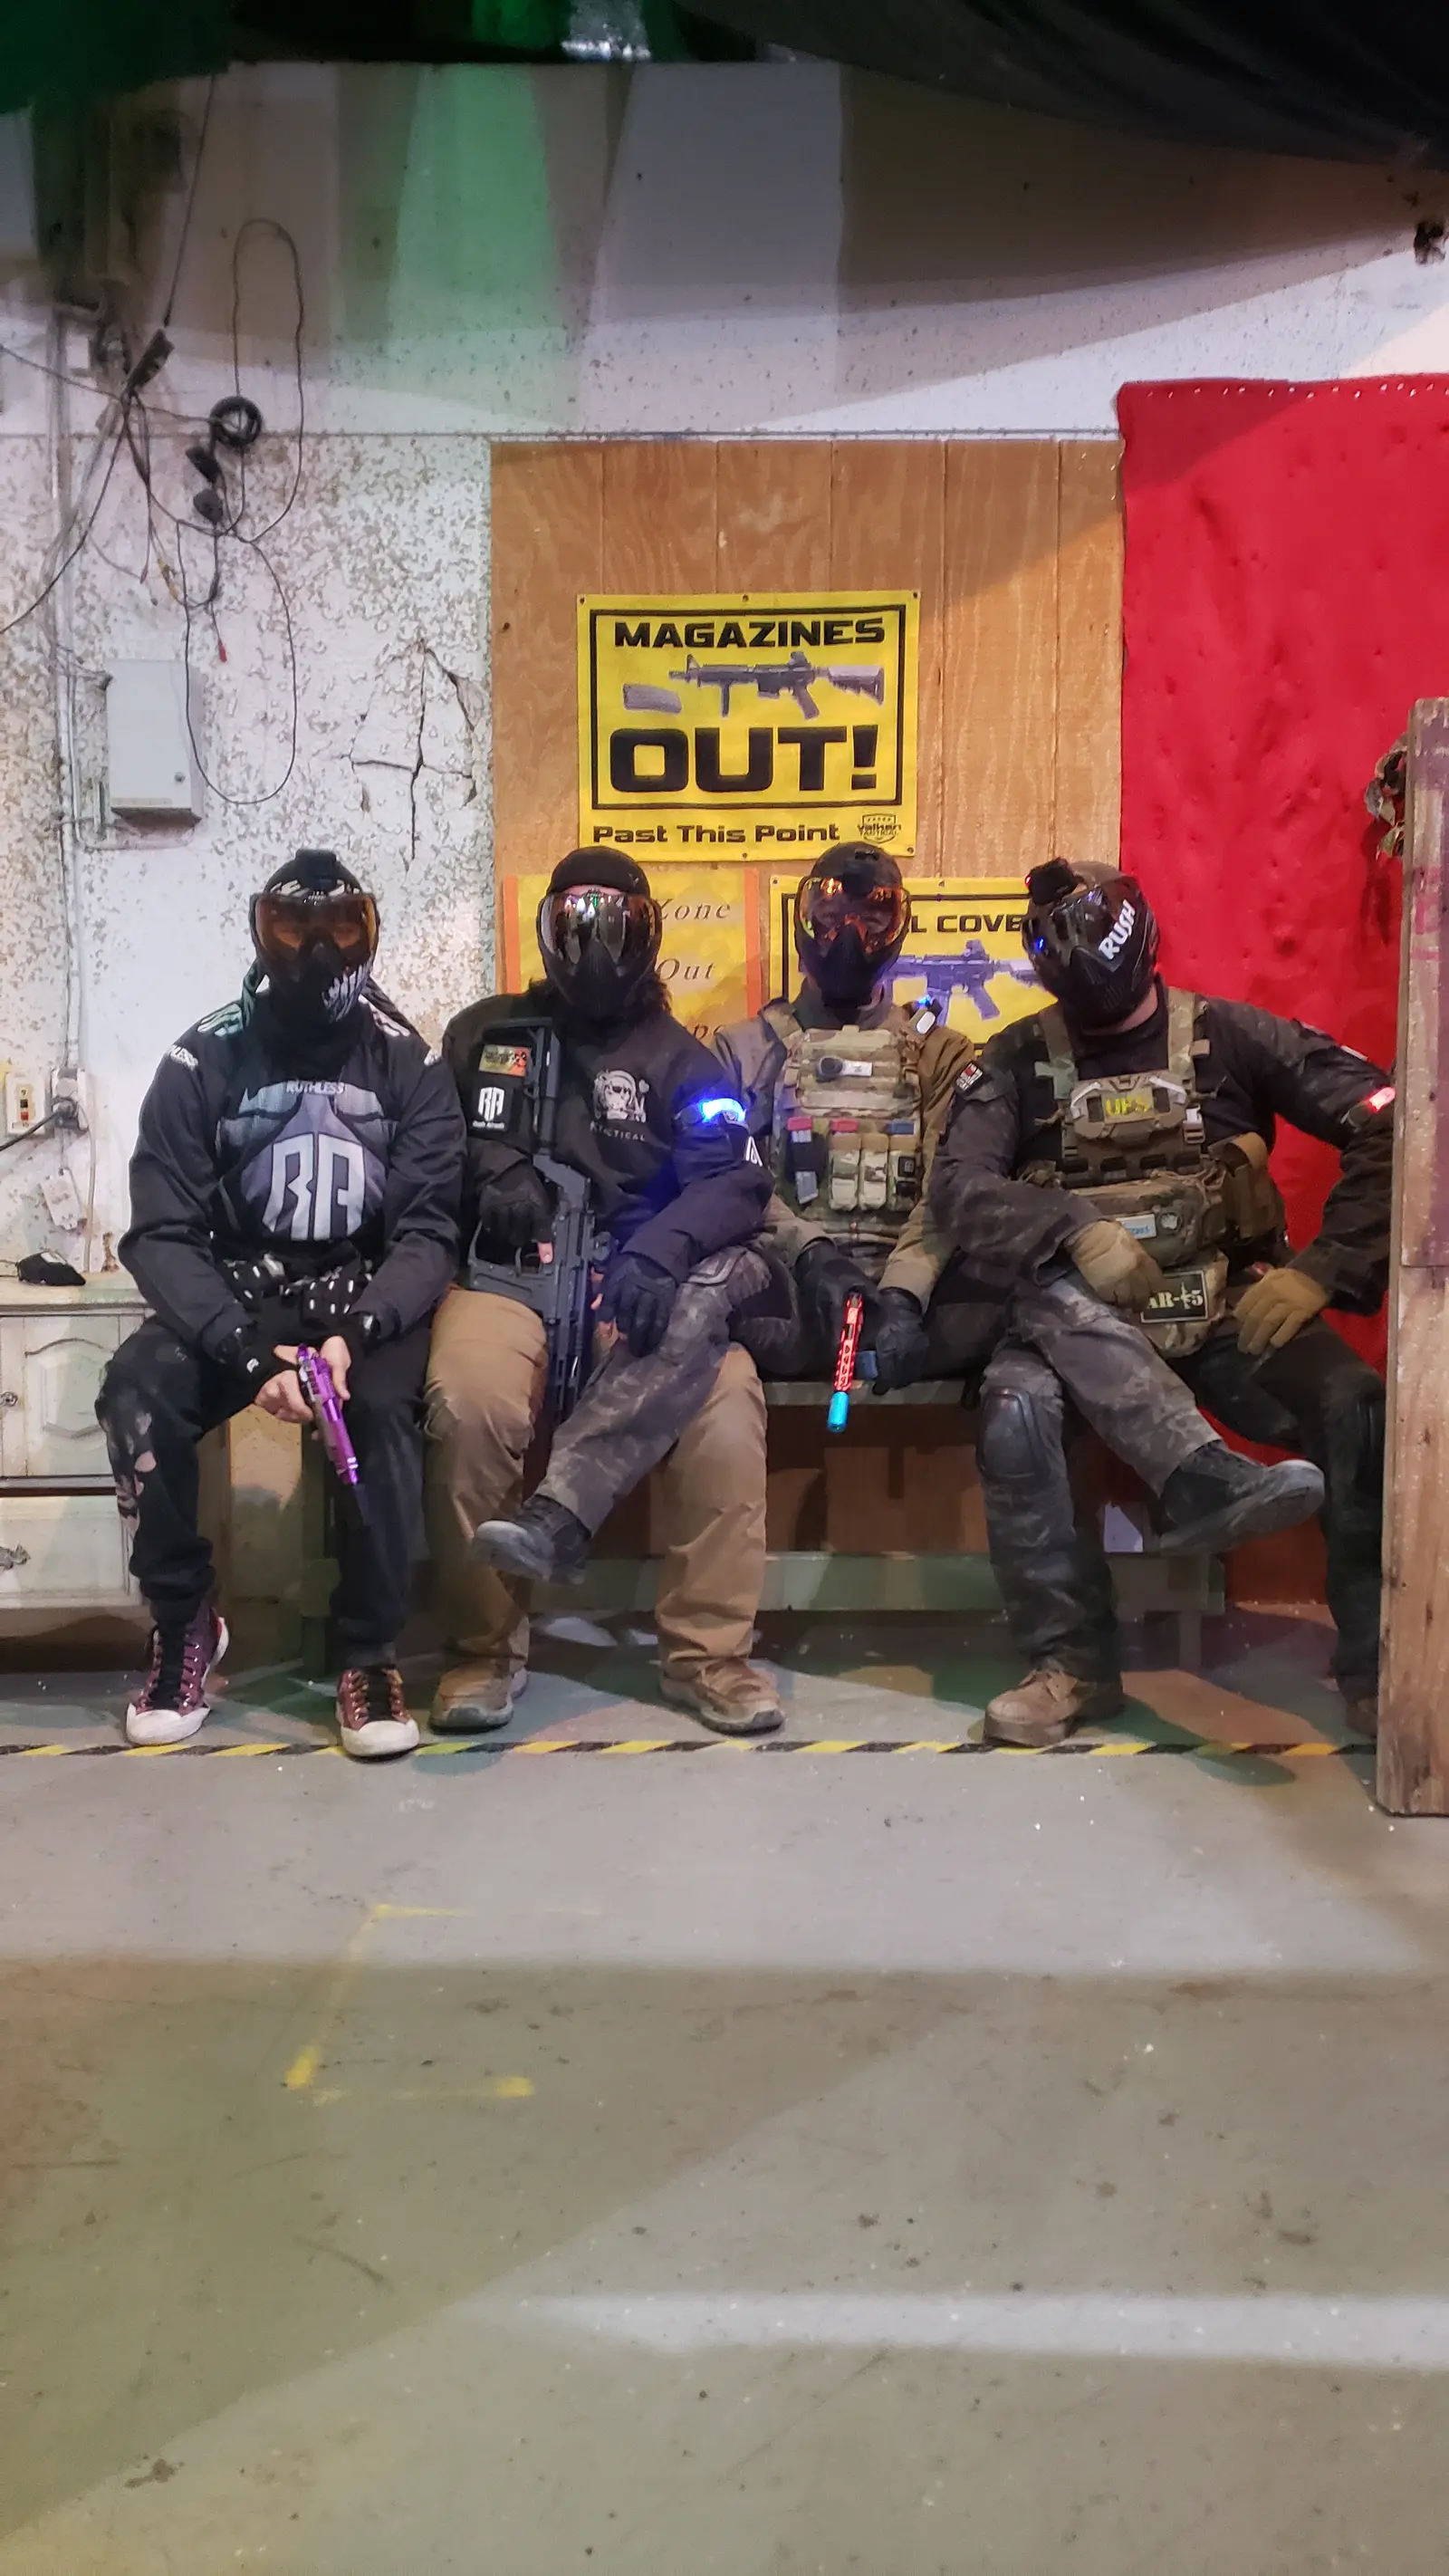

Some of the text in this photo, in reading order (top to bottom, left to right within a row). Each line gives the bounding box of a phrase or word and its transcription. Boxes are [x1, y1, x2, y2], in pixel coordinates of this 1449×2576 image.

[615, 618, 885, 648] MAGAZINES
[609, 725, 878, 793] OUT!
[593, 823, 840, 843] Past This Point
[936, 914, 1023, 933] COVE
[1098, 899, 1136, 960] RUSH
[656, 957, 715, 981] Out
